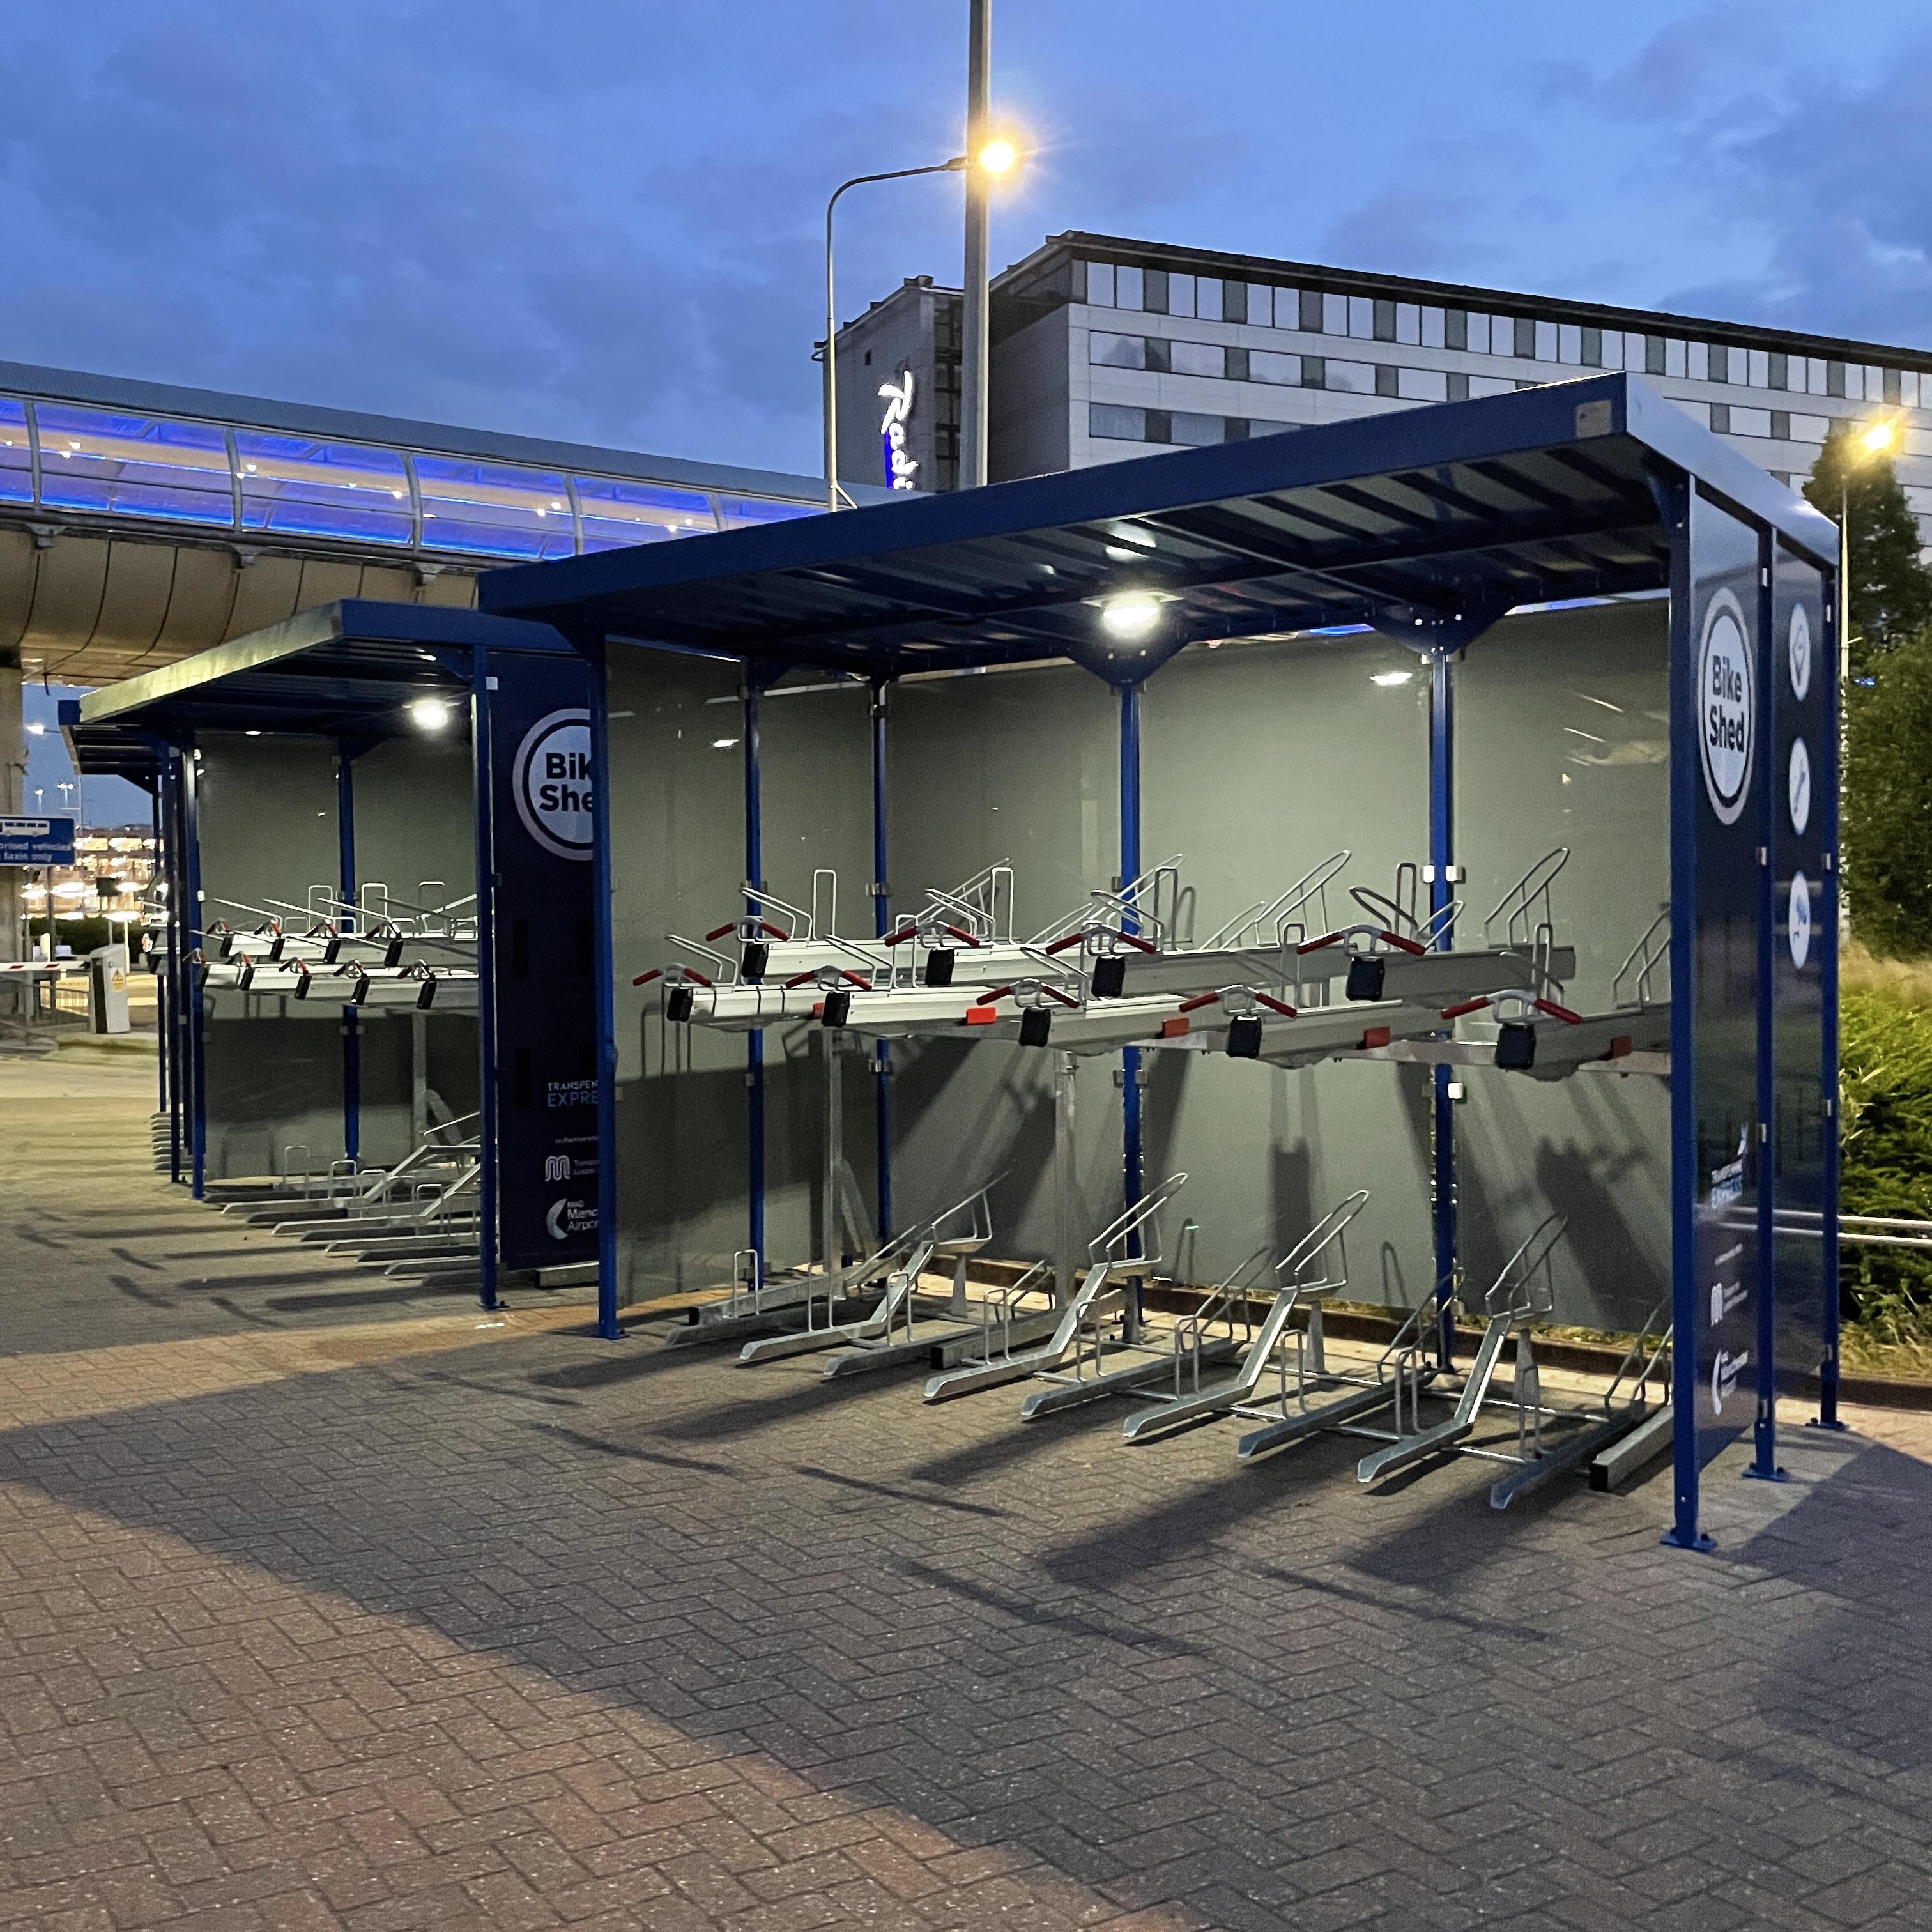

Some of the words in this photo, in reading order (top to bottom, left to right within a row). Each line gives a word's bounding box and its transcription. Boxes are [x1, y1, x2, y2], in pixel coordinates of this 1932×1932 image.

[878, 370, 919, 490] Radi
[1712, 655, 1742, 703] Bike
[1710, 704, 1744, 753] Shed
[546, 752, 592, 780] Bik
[539, 784, 594, 812] She
[546, 1080, 598, 1091] TRANSPEN
[546, 1091, 599, 1107] EXPRE
[567, 1220, 599, 1232] Airpor
